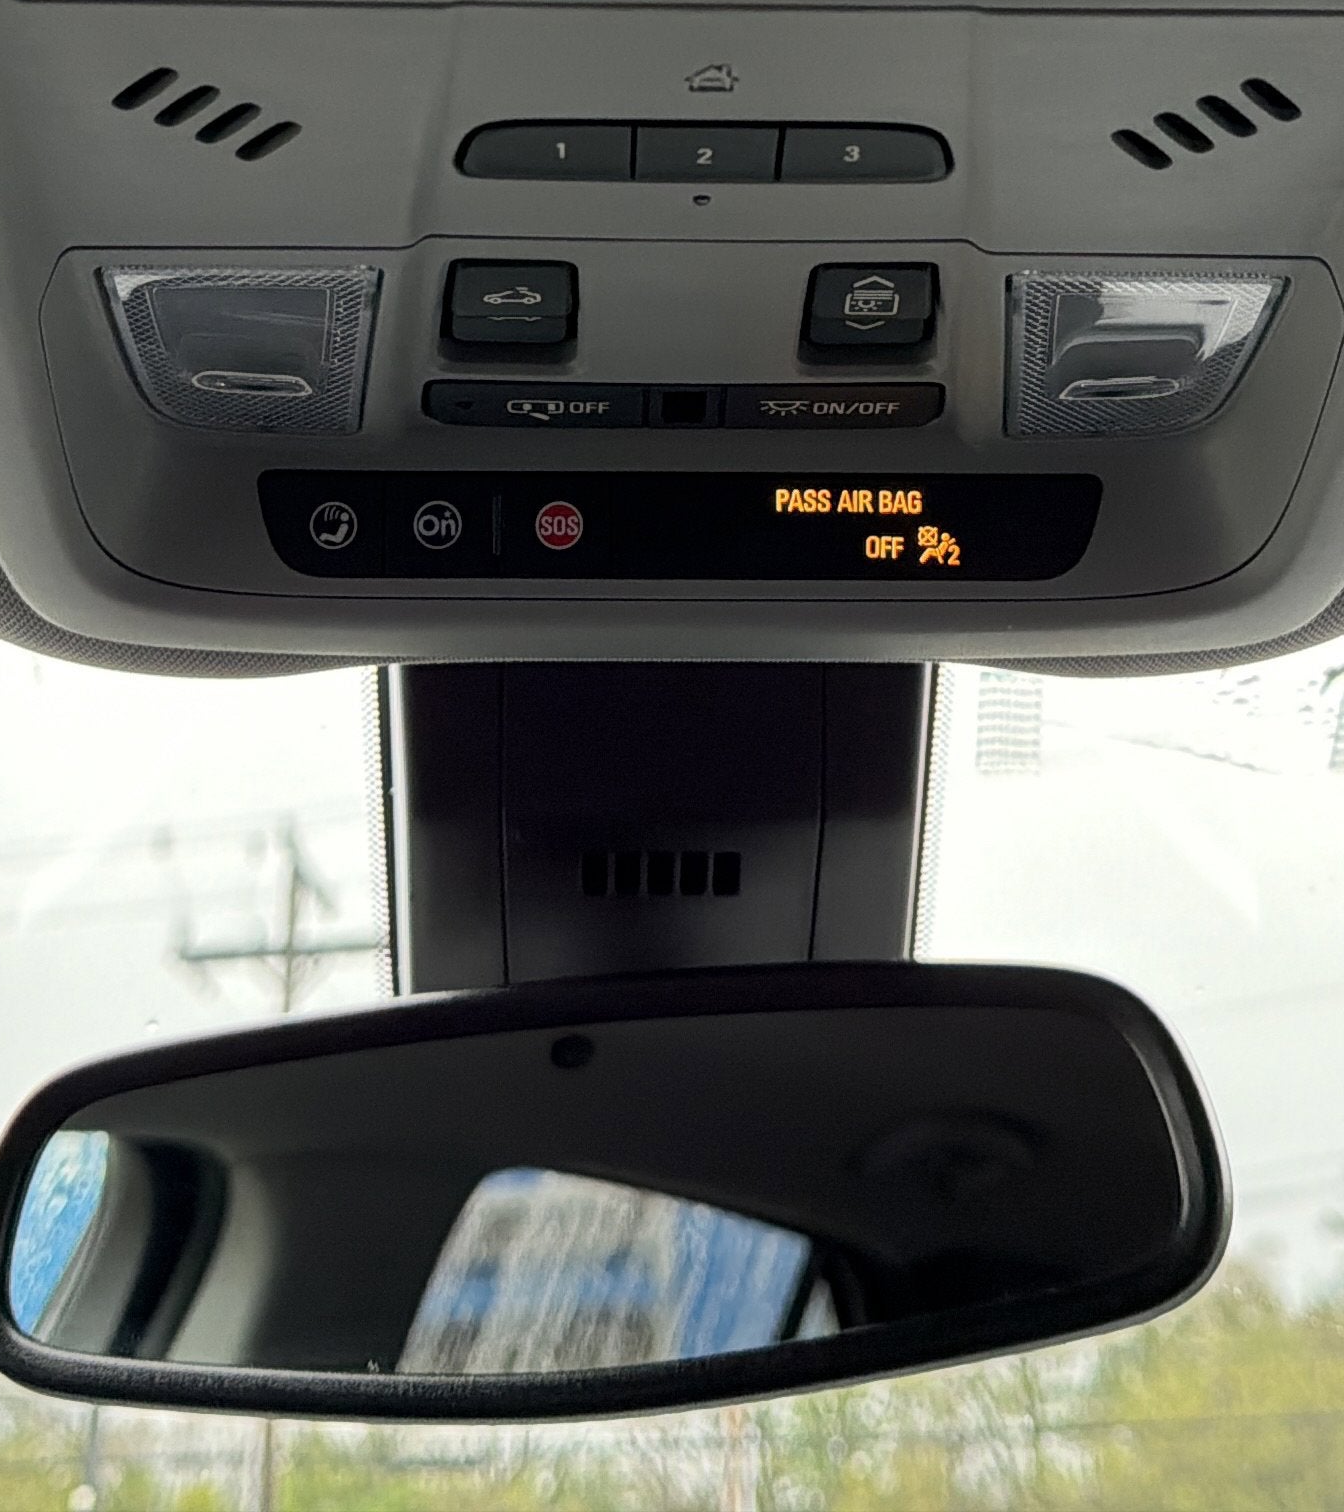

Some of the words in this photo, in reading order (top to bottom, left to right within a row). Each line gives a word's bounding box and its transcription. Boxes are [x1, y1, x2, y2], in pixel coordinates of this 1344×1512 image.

[555, 141, 567, 160] 1
[696, 147, 714, 165] 2
[843, 144, 861, 162] 3
[568, 400, 611, 415] OFF
[811, 400, 901, 416] ON/OFF
[775, 489, 832, 513] PASS
[836, 490, 875, 513] AIR
[878, 490, 923, 515] BAG
[418, 512, 456, 537] On
[540, 515, 579, 537] SOS
[865, 535, 905, 560] OFF
